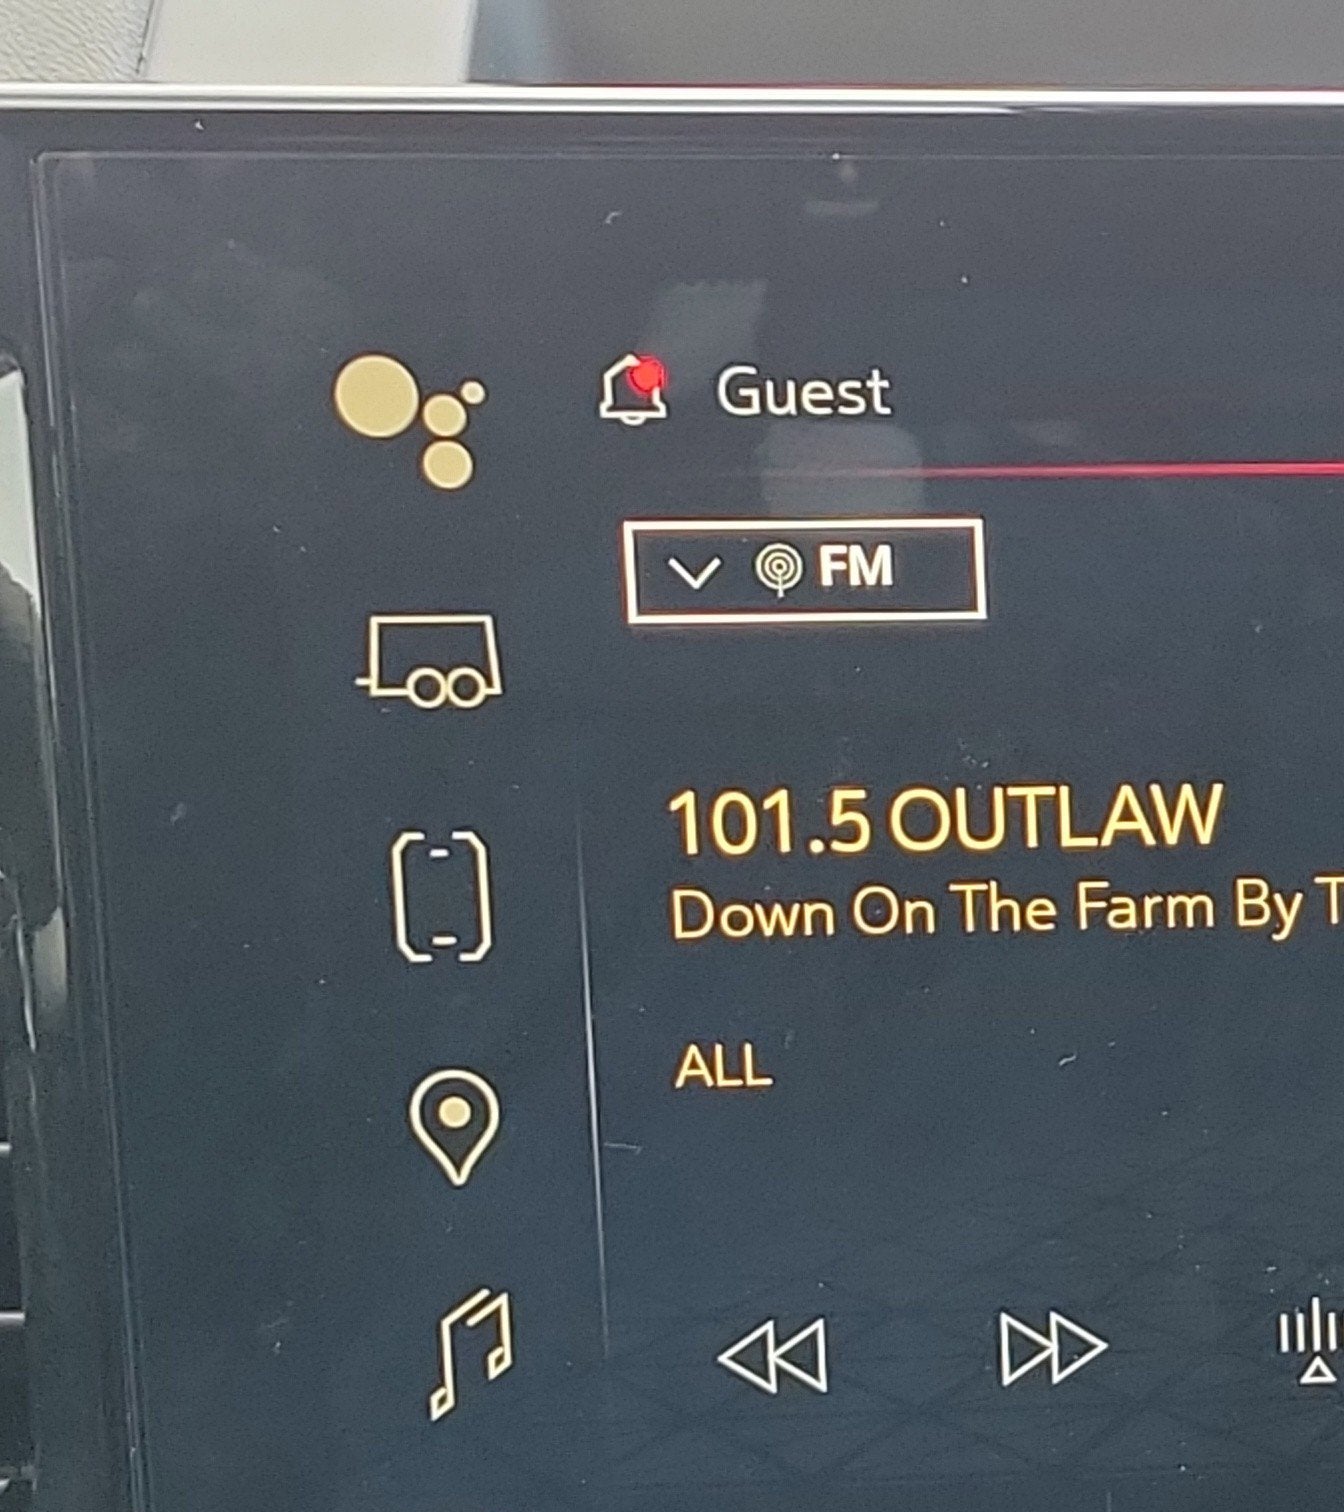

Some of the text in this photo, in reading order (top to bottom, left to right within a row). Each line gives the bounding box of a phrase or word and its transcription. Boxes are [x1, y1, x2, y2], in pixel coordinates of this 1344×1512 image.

[718, 365, 891, 416] Guest
[819, 544, 893, 587] FM
[669, 783, 1224, 856] 101.5 OUTLAW
[672, 889, 835, 939] Down
[853, 886, 935, 935] On
[948, 880, 1057, 933] The
[1078, 881, 1214, 930] Farm
[1236, 878, 1304, 941] By
[675, 1043, 773, 1088] ALL
